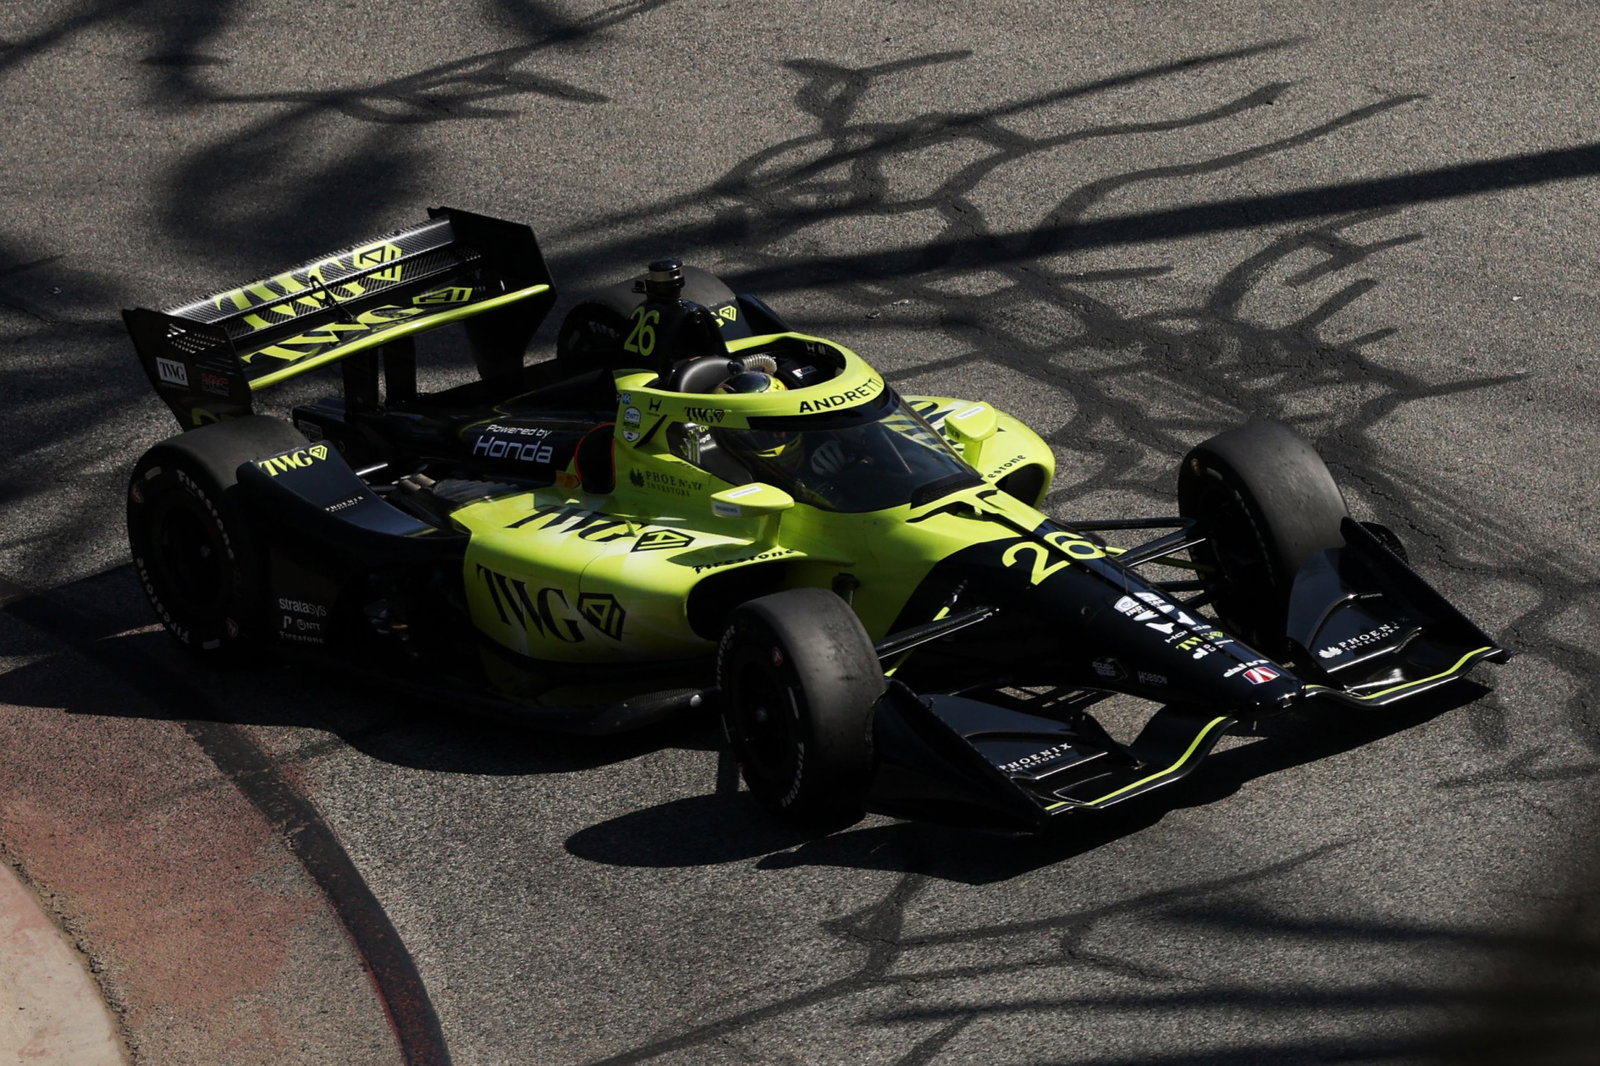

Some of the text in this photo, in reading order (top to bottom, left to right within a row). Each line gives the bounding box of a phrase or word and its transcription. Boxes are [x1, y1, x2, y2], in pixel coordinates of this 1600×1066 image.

[624, 305, 660, 356] 26
[159, 361, 186, 382] TWG
[684, 407, 714, 422] TWG
[486, 424, 553, 439] Powered by
[258, 449, 314, 477] TWG
[473, 435, 554, 464] Honda
[505, 505, 650, 542] TWG
[1001, 531, 1106, 586] 26
[278, 598, 328, 617] stratasys
[476, 563, 585, 644] TWG
[998, 743, 1072, 770] PHOENIX
